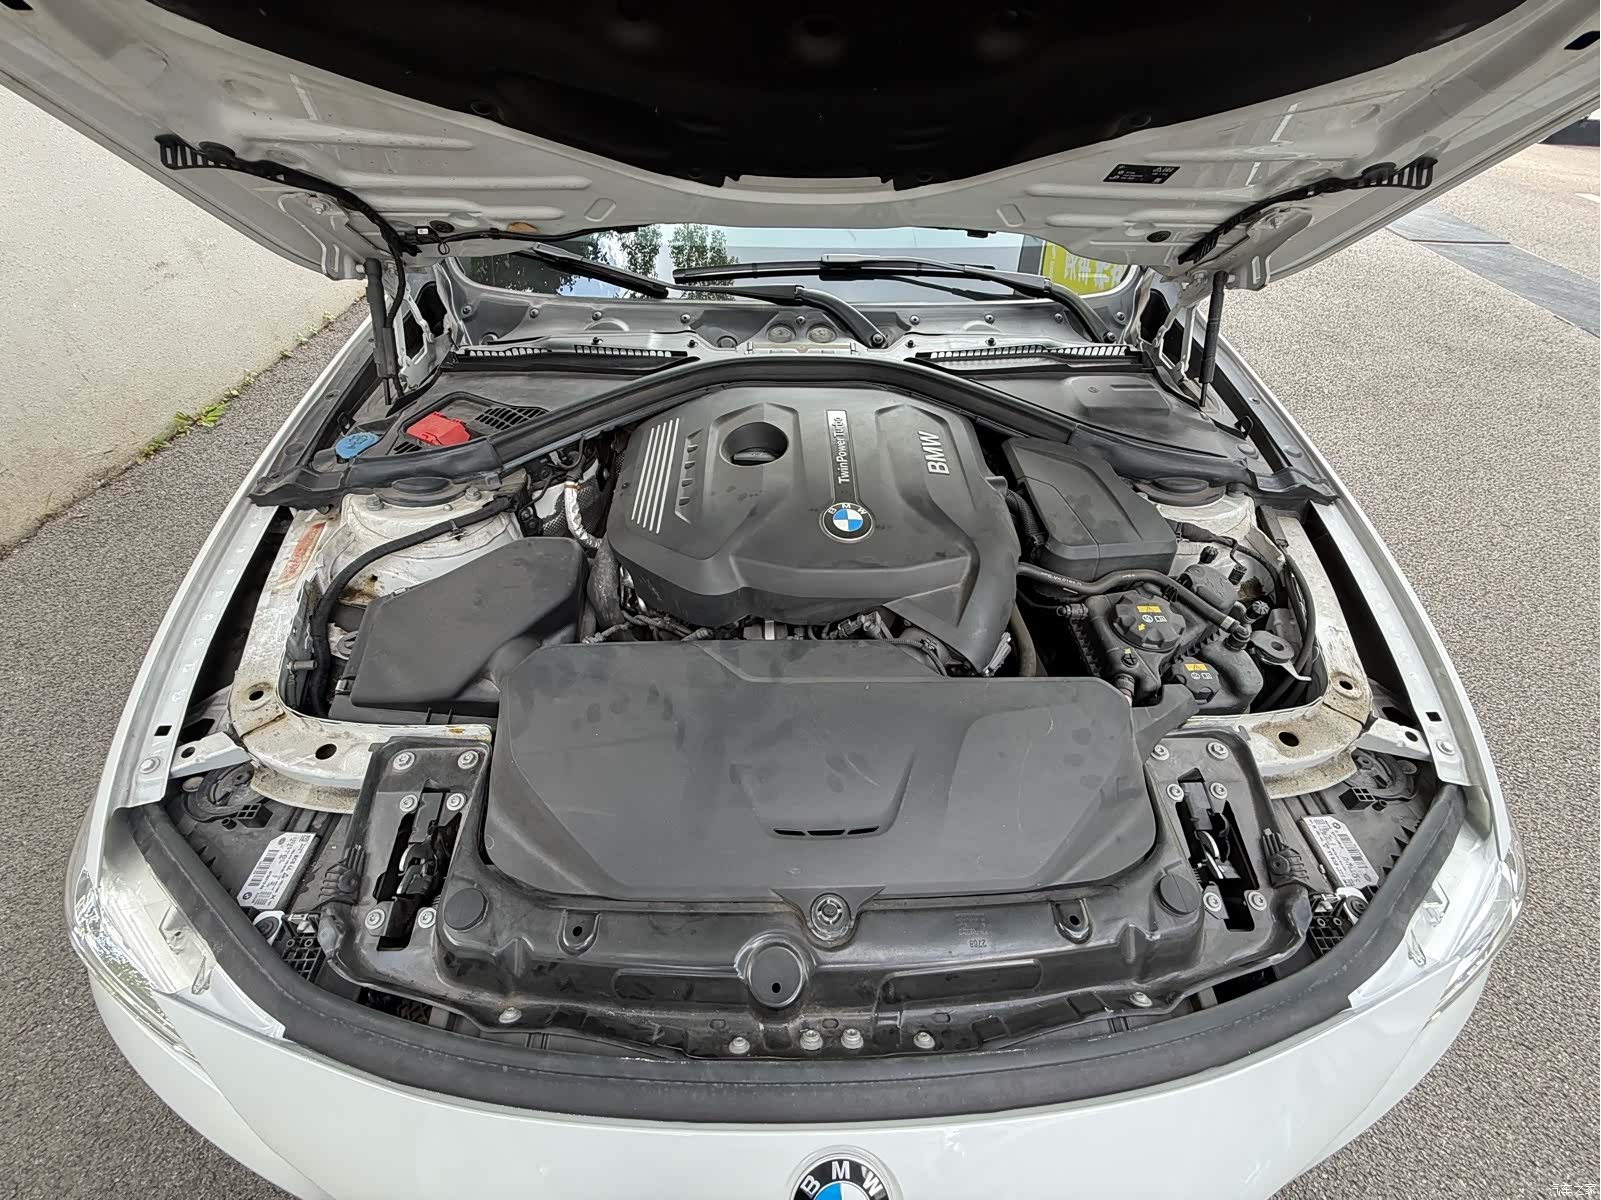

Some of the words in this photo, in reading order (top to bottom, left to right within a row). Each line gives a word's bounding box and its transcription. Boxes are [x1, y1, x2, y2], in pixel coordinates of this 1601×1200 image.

[918, 430, 950, 475] BMW
[828, 503, 867, 515] BMW
[800, 1160, 883, 1197] BMW
